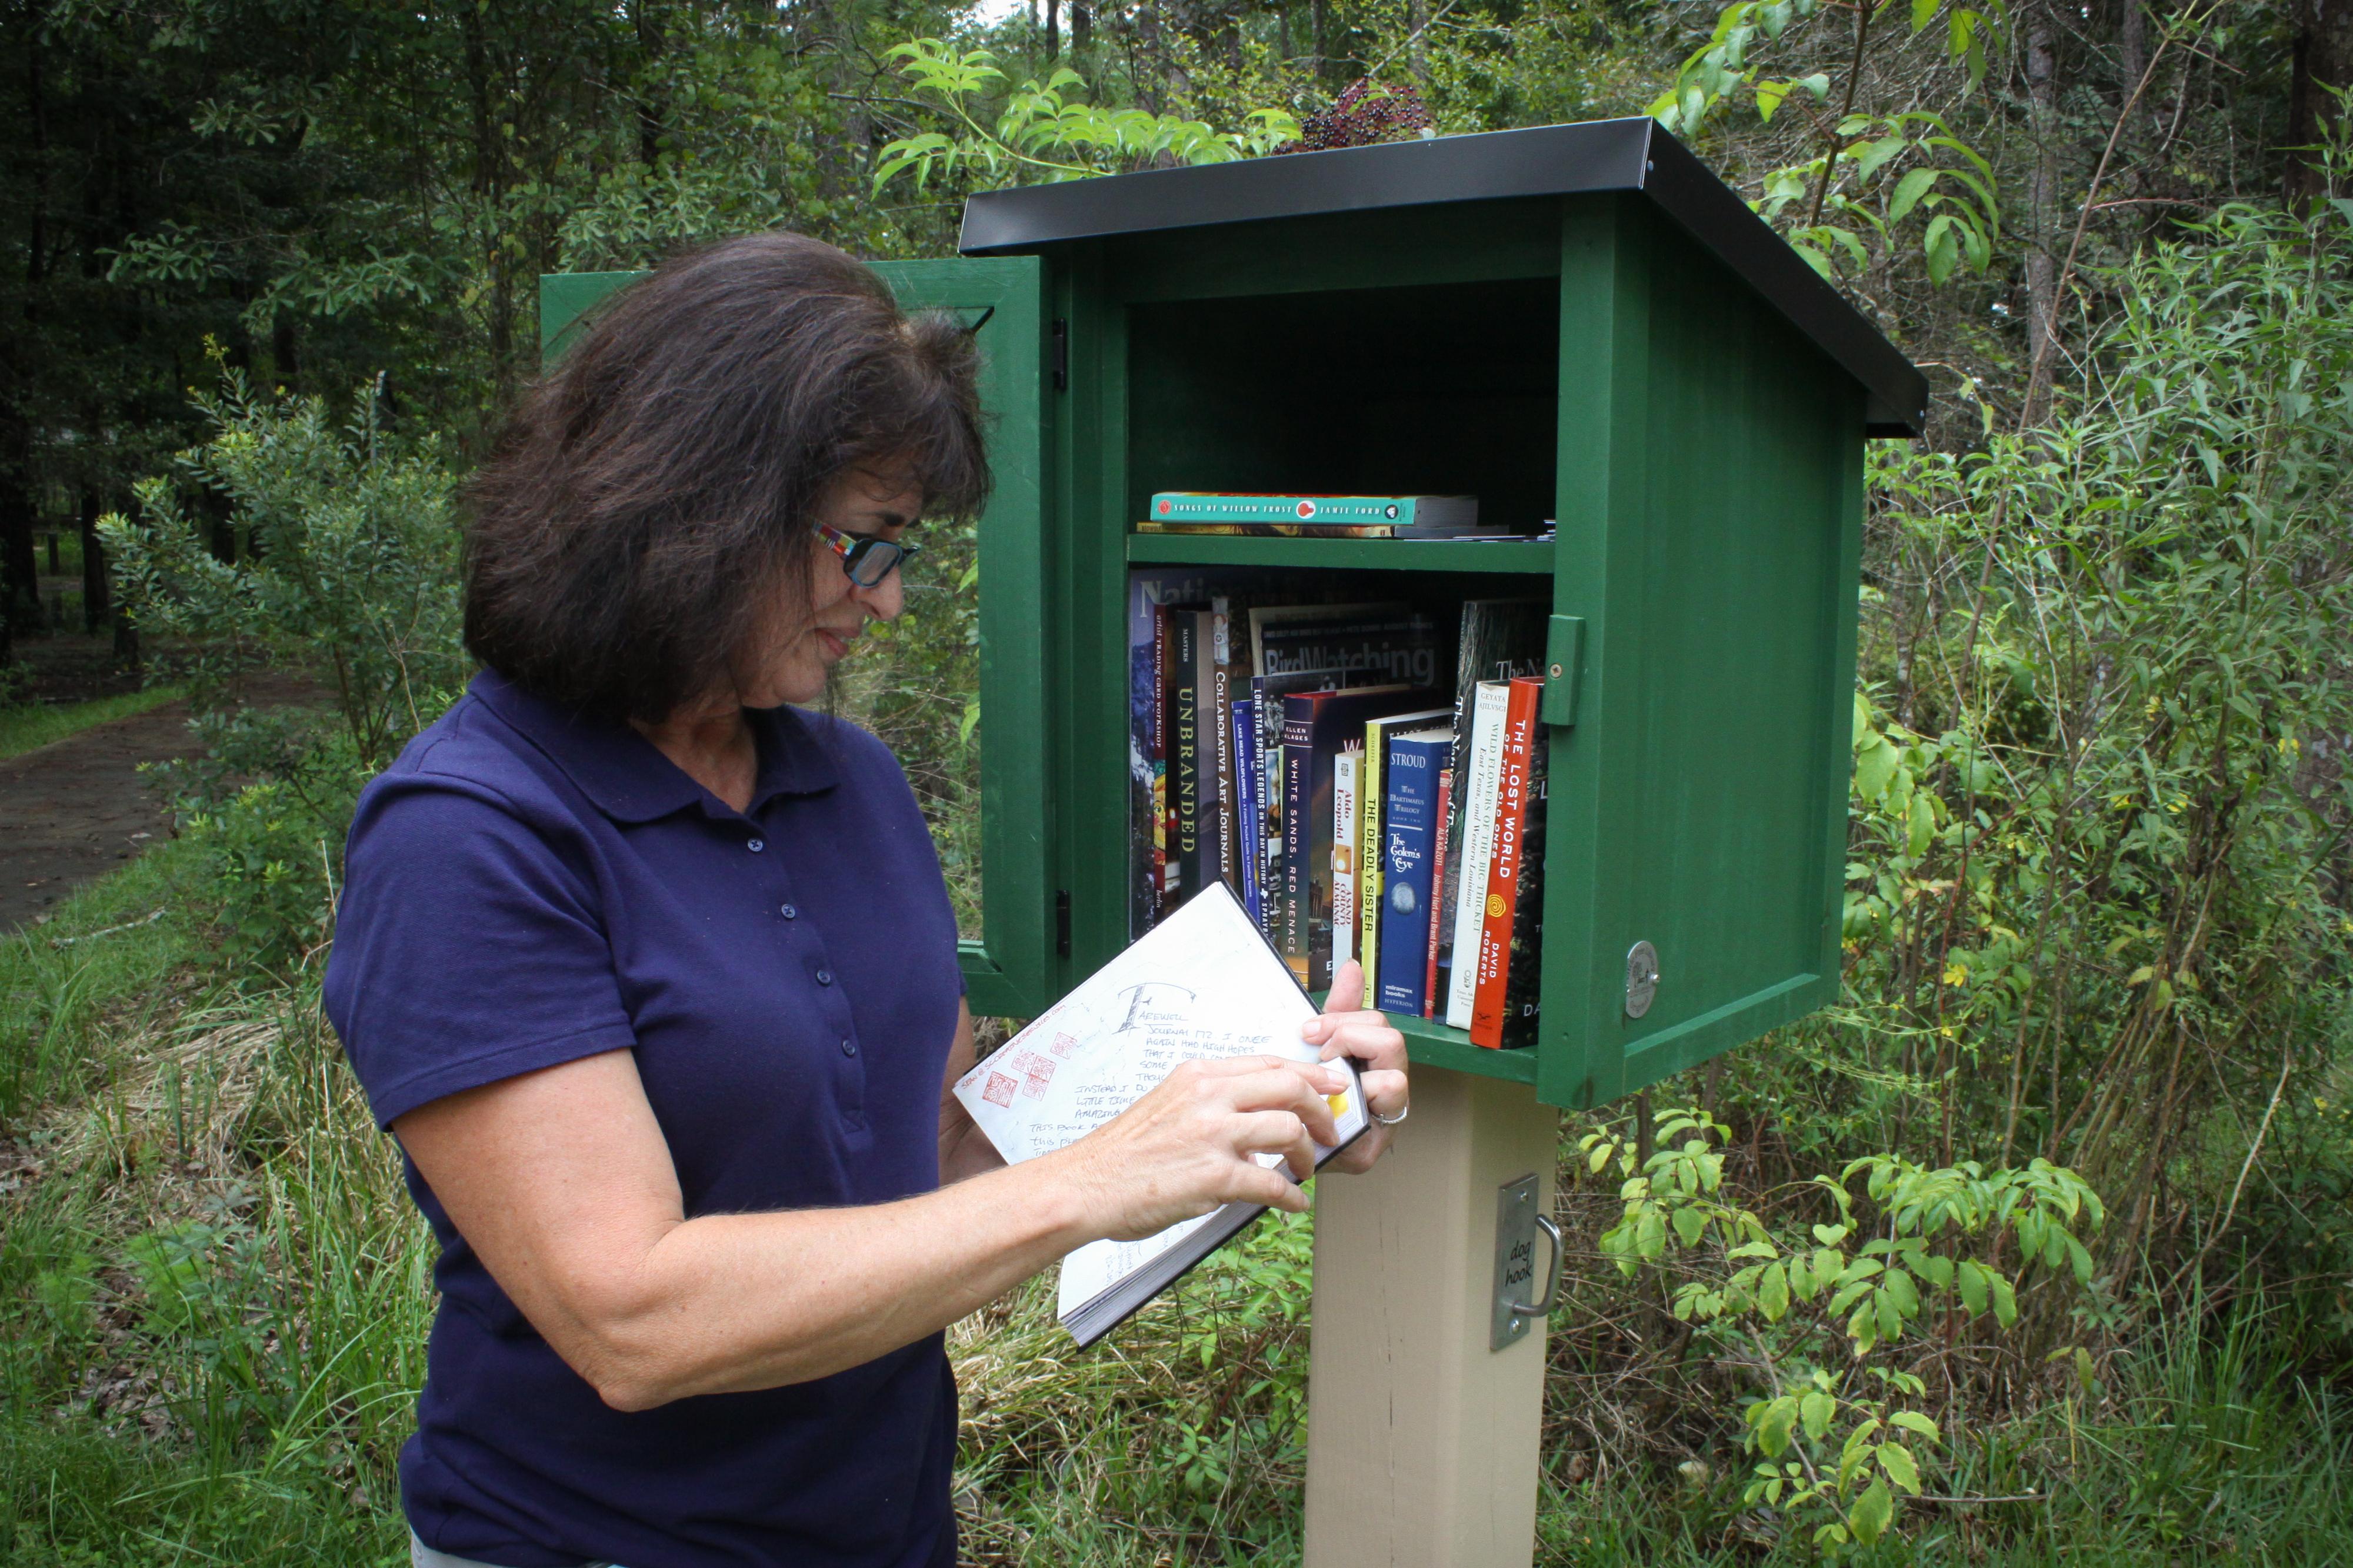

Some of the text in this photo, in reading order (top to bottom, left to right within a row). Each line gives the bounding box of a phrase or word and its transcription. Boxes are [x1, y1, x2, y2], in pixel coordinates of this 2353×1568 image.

[1355, 506, 1380, 515] FORD
[1265, 642, 1434, 686] BirdWatching
[1254, 689, 1262, 710] LONE
[1481, 692, 1506, 702] GEYATA
[1254, 713, 1263, 734] STAR
[1504, 733, 1509, 751] OF
[1255, 737, 1264, 769] SPORTS
[1391, 753, 1426, 769] STROUD
[1478, 748, 1487, 768] East
[1179, 687, 1195, 852] UNBRANDED
[1215, 671, 1229, 873] COLLABORATIVE ART JOURNALS
[1290, 759, 1298, 802] WHITE
[1401, 785, 1415, 794] THE
[1475, 772, 1485, 800] Texas,
[1257, 772, 1265, 809] LEGENDS
[1389, 794, 1424, 805] BARTIMAEUS
[1499, 720, 1526, 878] THE LOST WORLD
[1259, 812, 1264, 820] ON
[1335, 789, 1344, 839] Leopold
[1394, 804, 1420, 814] TRILOGY
[1289, 809, 1298, 858] SANDS,
[1473, 723, 1499, 932] WILD FLOWERS OF THE BIG THICKET
[1390, 833, 1405, 846] The
[1471, 823, 1479, 861] Western
[1491, 823, 1500, 858] ONES
[1390, 845, 1421, 861] Golem's
[1364, 799, 1376, 932] THE DEADLY SISTER
[1395, 857, 1414, 872] Eye
[1465, 864, 1476, 908] Louisiana
[1288, 899, 1296, 953] MENACE
[1429, 925, 1438, 940] Brant
[1428, 941, 1437, 960] Parker
[1479, 930, 1491, 985] ROBERTS
[1489, 942, 1499, 978] DAVID
[1385, 985, 1413, 994] miramax
[1385, 990, 1405, 998] books
[1384, 998, 1413, 1007] HYPERION
[1222, 1032, 1232, 1040] I
[1142, 1049, 1165, 1059] THAT
[1181, 1051, 1206, 1060] COULD
[1146, 1037, 1255, 1056] AGAIN HAD HIGH HOPES
[1139, 1060, 1168, 1069] SOME
[1074, 1084, 1117, 1094] INSTEAD
[1076, 1096, 1136, 1106] LITTLE TIME
[1074, 1109, 1121, 1119] AMAZING
[1029, 1123, 1054, 1133] THIS
[1056, 1123, 1087, 1132] BOOK
[1029, 1136, 1055, 1146] this
[1510, 1239, 1531, 1262] dog
[1505, 1259, 1532, 1287] hook
